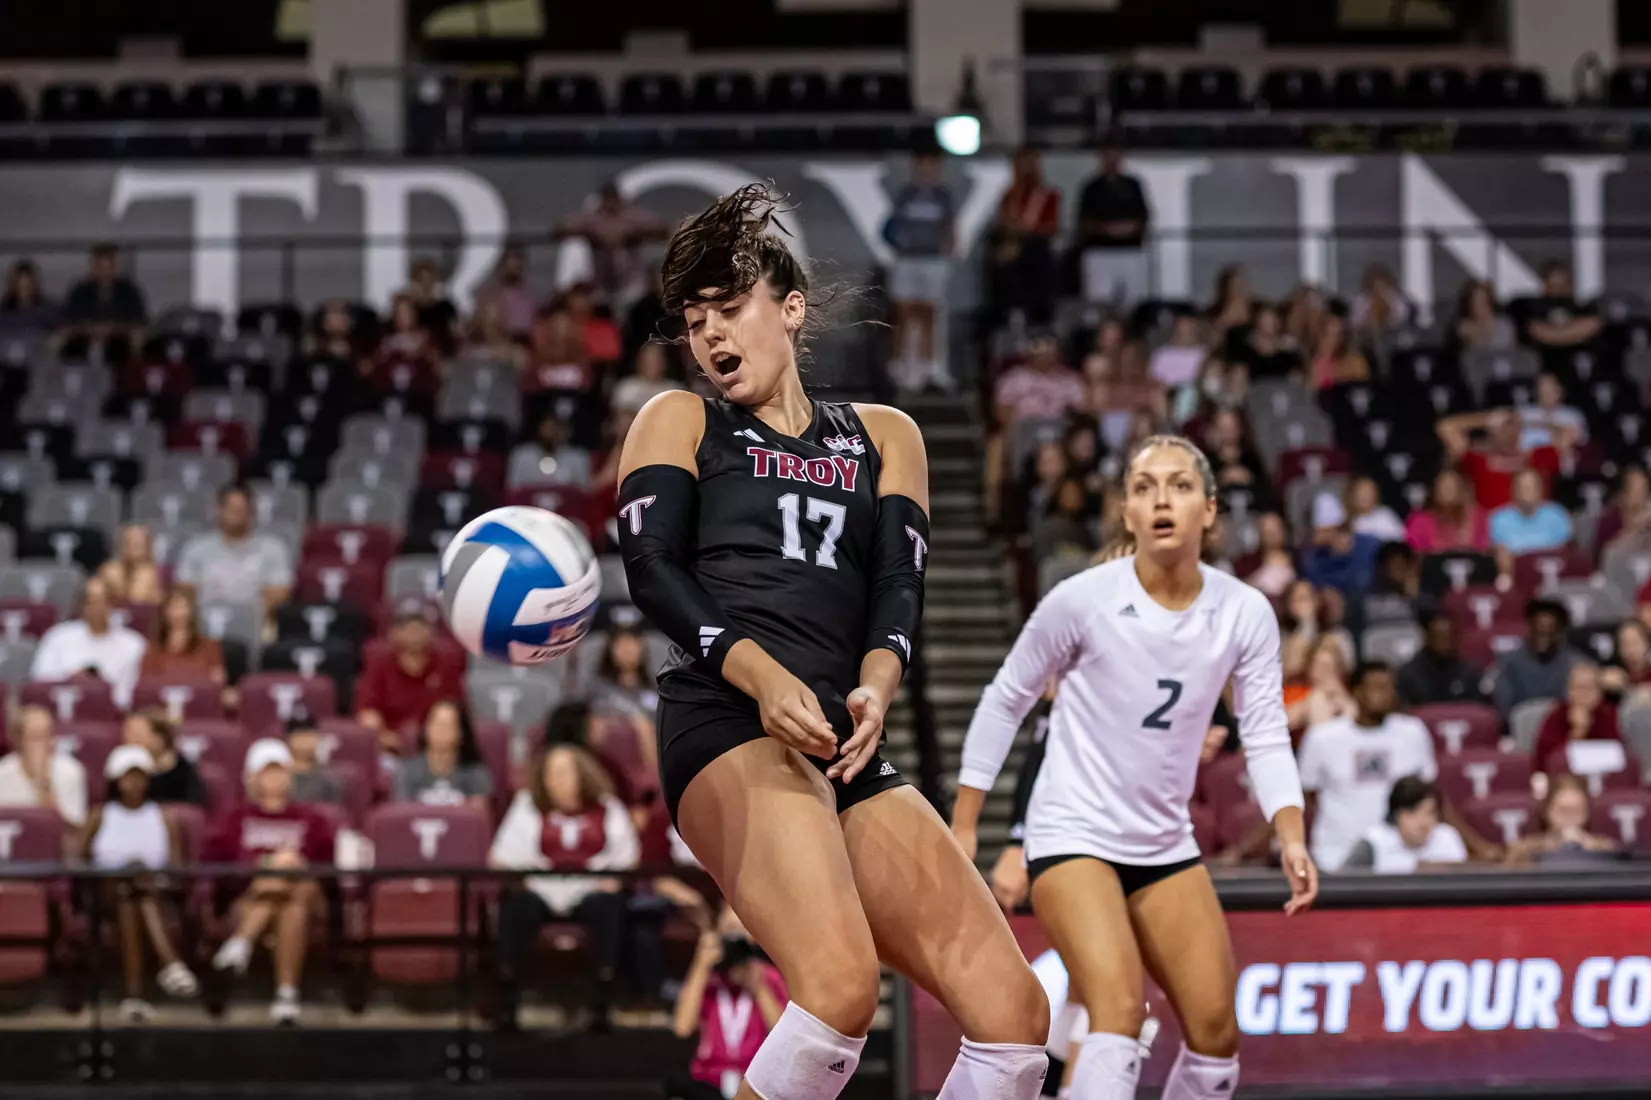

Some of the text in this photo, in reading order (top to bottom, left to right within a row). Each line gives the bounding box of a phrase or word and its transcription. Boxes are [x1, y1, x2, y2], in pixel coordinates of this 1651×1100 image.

[747, 446, 858, 492] TROY
[777, 492, 847, 570] 17
[1141, 680, 1182, 730] 2
[1235, 955, 1651, 1035] GET YOUR CO
